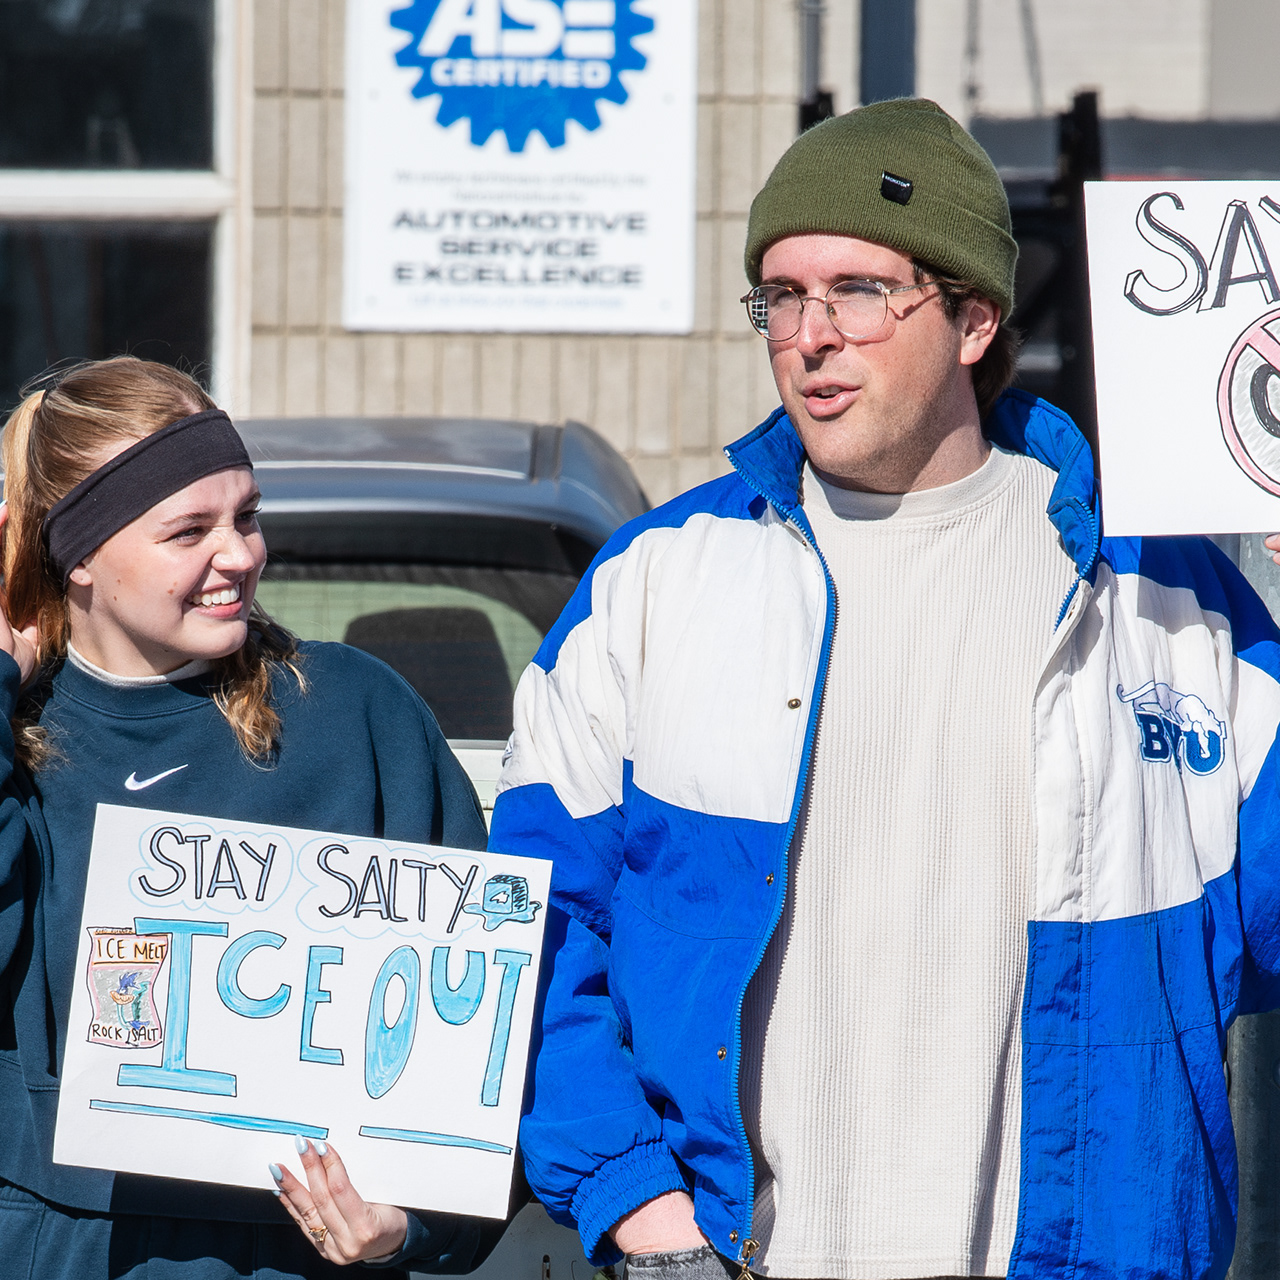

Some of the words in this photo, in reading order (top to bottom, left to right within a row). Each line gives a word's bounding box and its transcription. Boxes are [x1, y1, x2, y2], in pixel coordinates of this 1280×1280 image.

[416, 0, 617, 59] ASE
[430, 59, 612, 88] CERTIFIED
[394, 210, 647, 232] AUTOMOTIVE
[440, 237, 599, 258] SERVICE
[394, 264, 643, 287] EXCELLENCE
[1134, 710, 1228, 776] BYU
[139, 827, 278, 901] STAY
[317, 844, 479, 933] SALTY
[97, 938, 125, 959] ICE
[134, 942, 167, 960] MELT
[117, 917, 344, 1098] ICE
[364, 945, 532, 1107] OUT
[92, 1024, 123, 1040] ROCK
[131, 1026, 159, 1042] SALT
